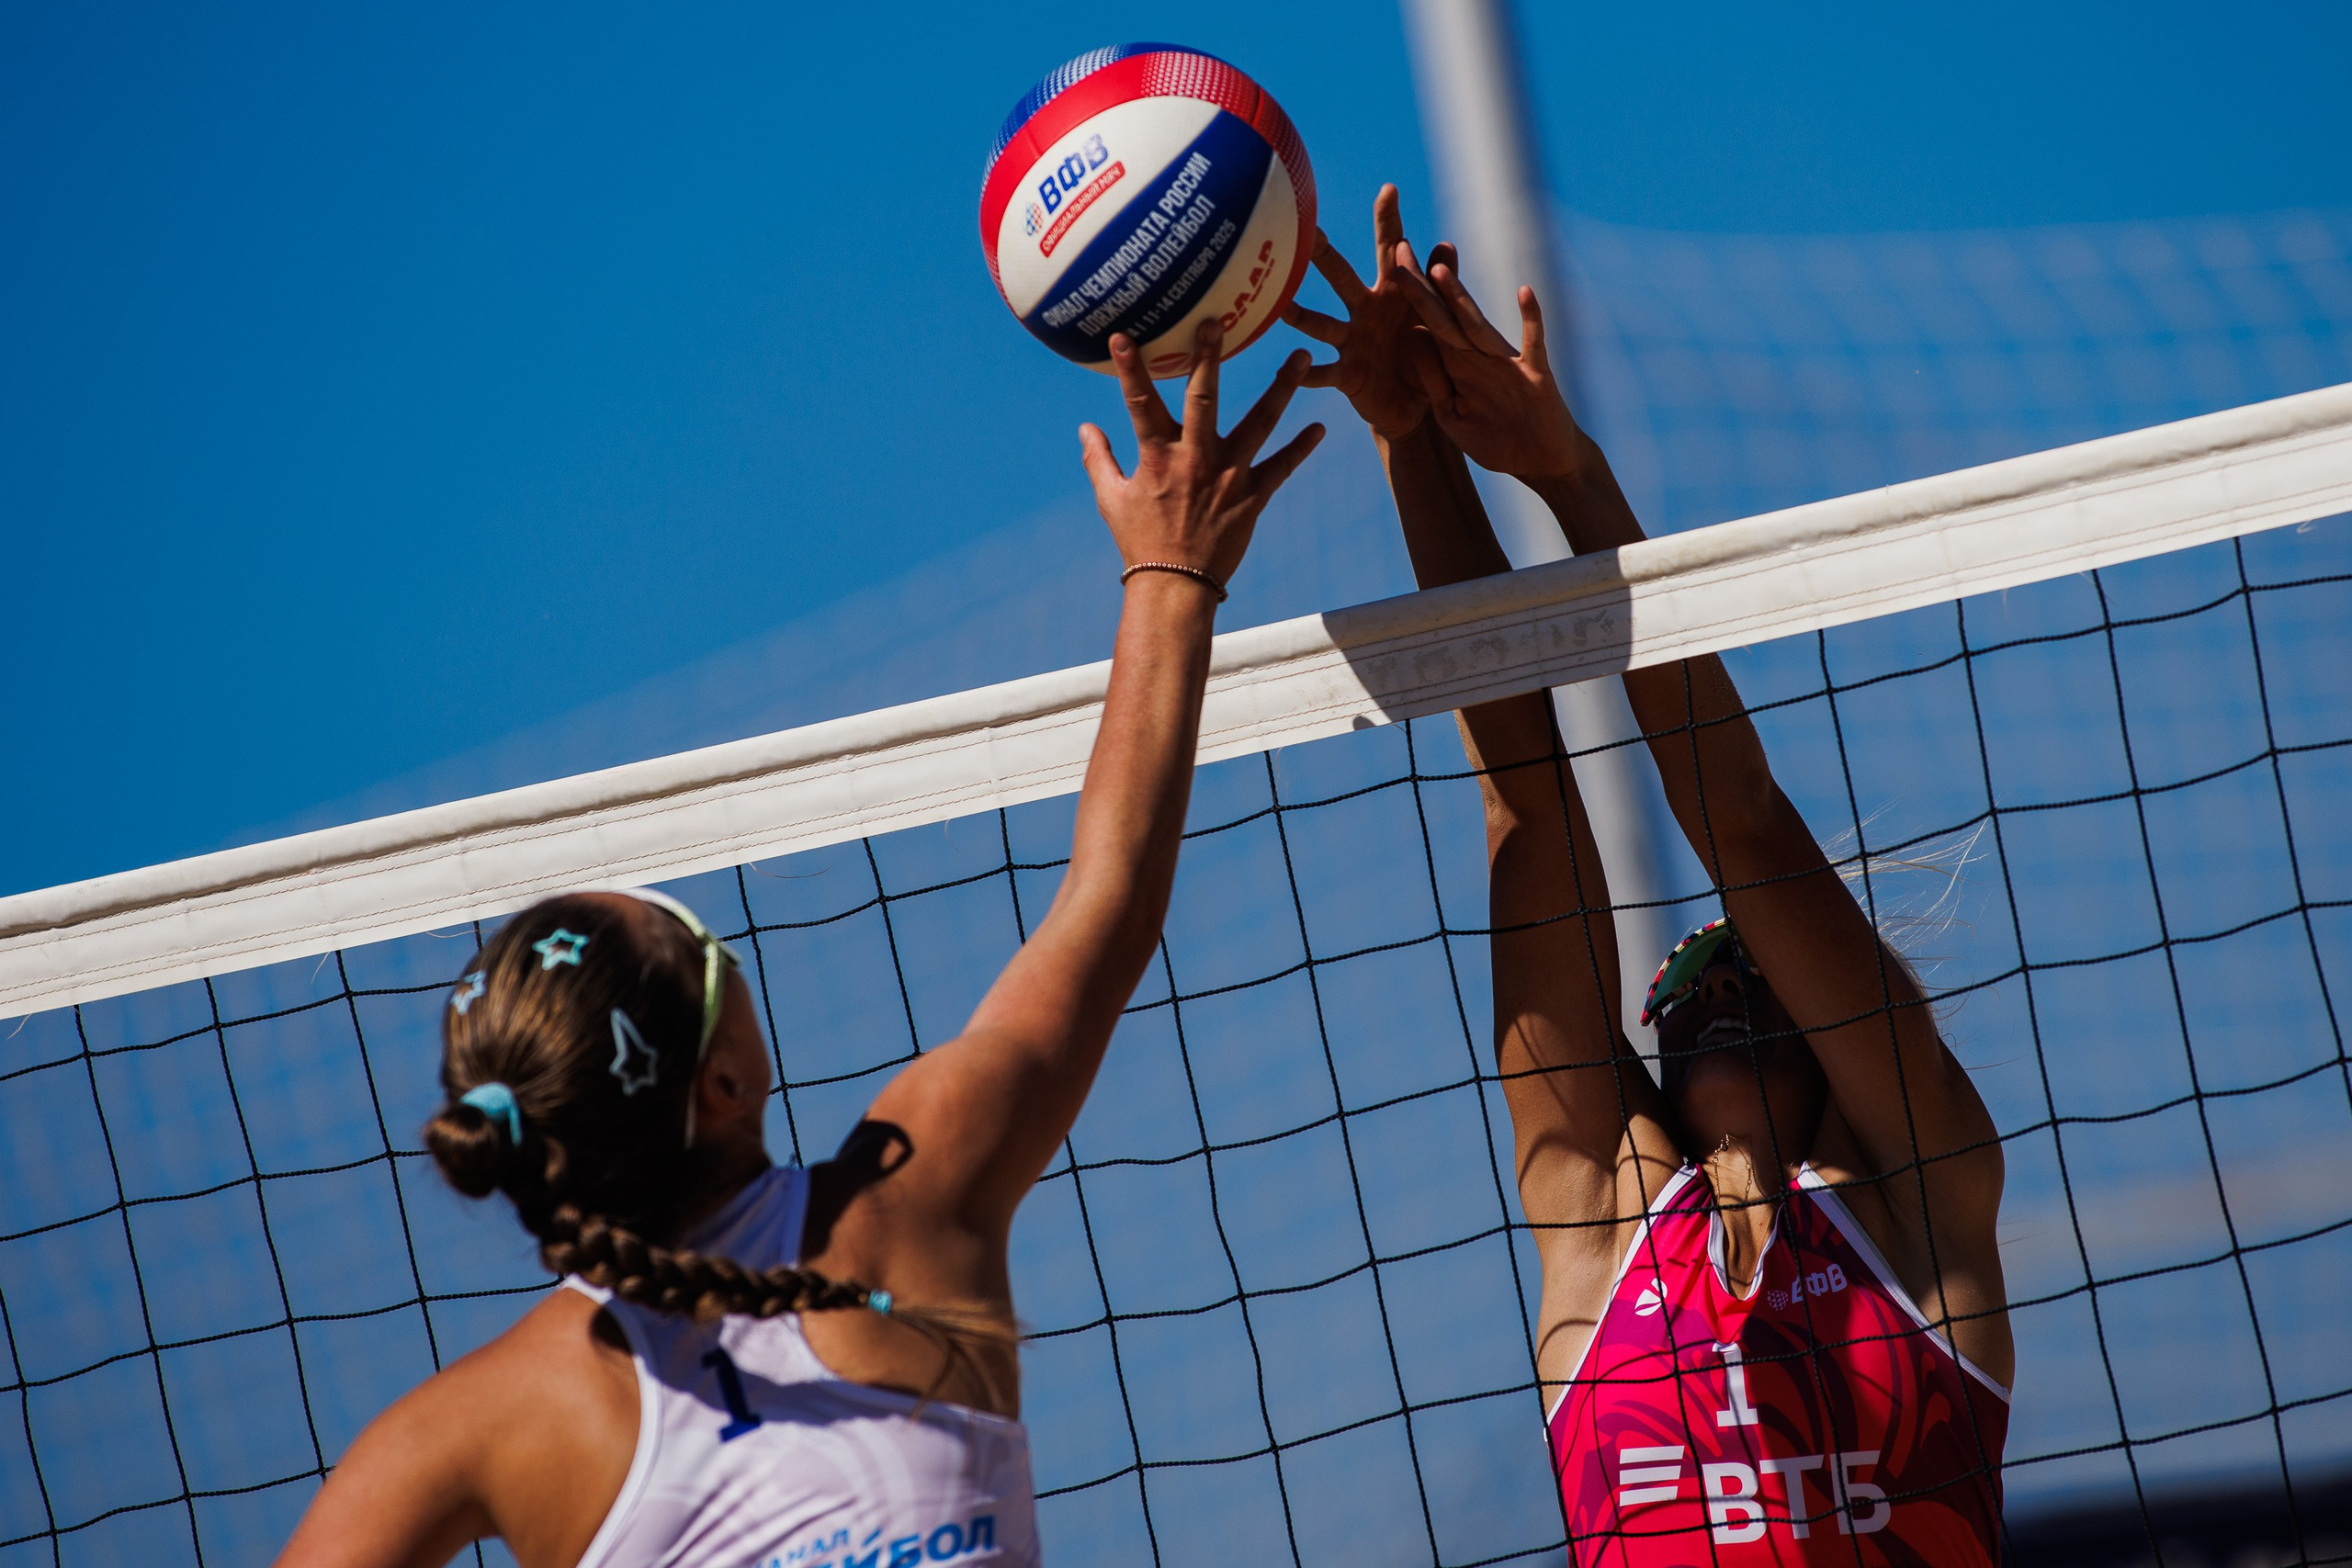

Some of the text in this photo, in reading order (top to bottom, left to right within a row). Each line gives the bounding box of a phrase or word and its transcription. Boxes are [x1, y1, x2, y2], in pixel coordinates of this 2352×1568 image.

[1037, 133, 1110, 214] ВФВ
[1041, 151, 1212, 327] ФИНАЛ ЧЕМПИОНАТА РОССИИ
[1077, 193, 1216, 337] ПЛЯЖНЫЙ ВОЛЕЙБОЛ
[1167, 245, 1216, 302] СЕНТЯБРЯ
[1208, 218, 1238, 251] 2025
[1218, 239, 1275, 333] ОЛАР
[1792, 1263, 1848, 1304] ВФВ
[702, 1348, 761, 1443] 1
[1712, 1342, 1758, 1427] 1
[815, 1516, 995, 1568] ЙБОЛ
[1702, 1450, 1892, 1545] ВТБ
